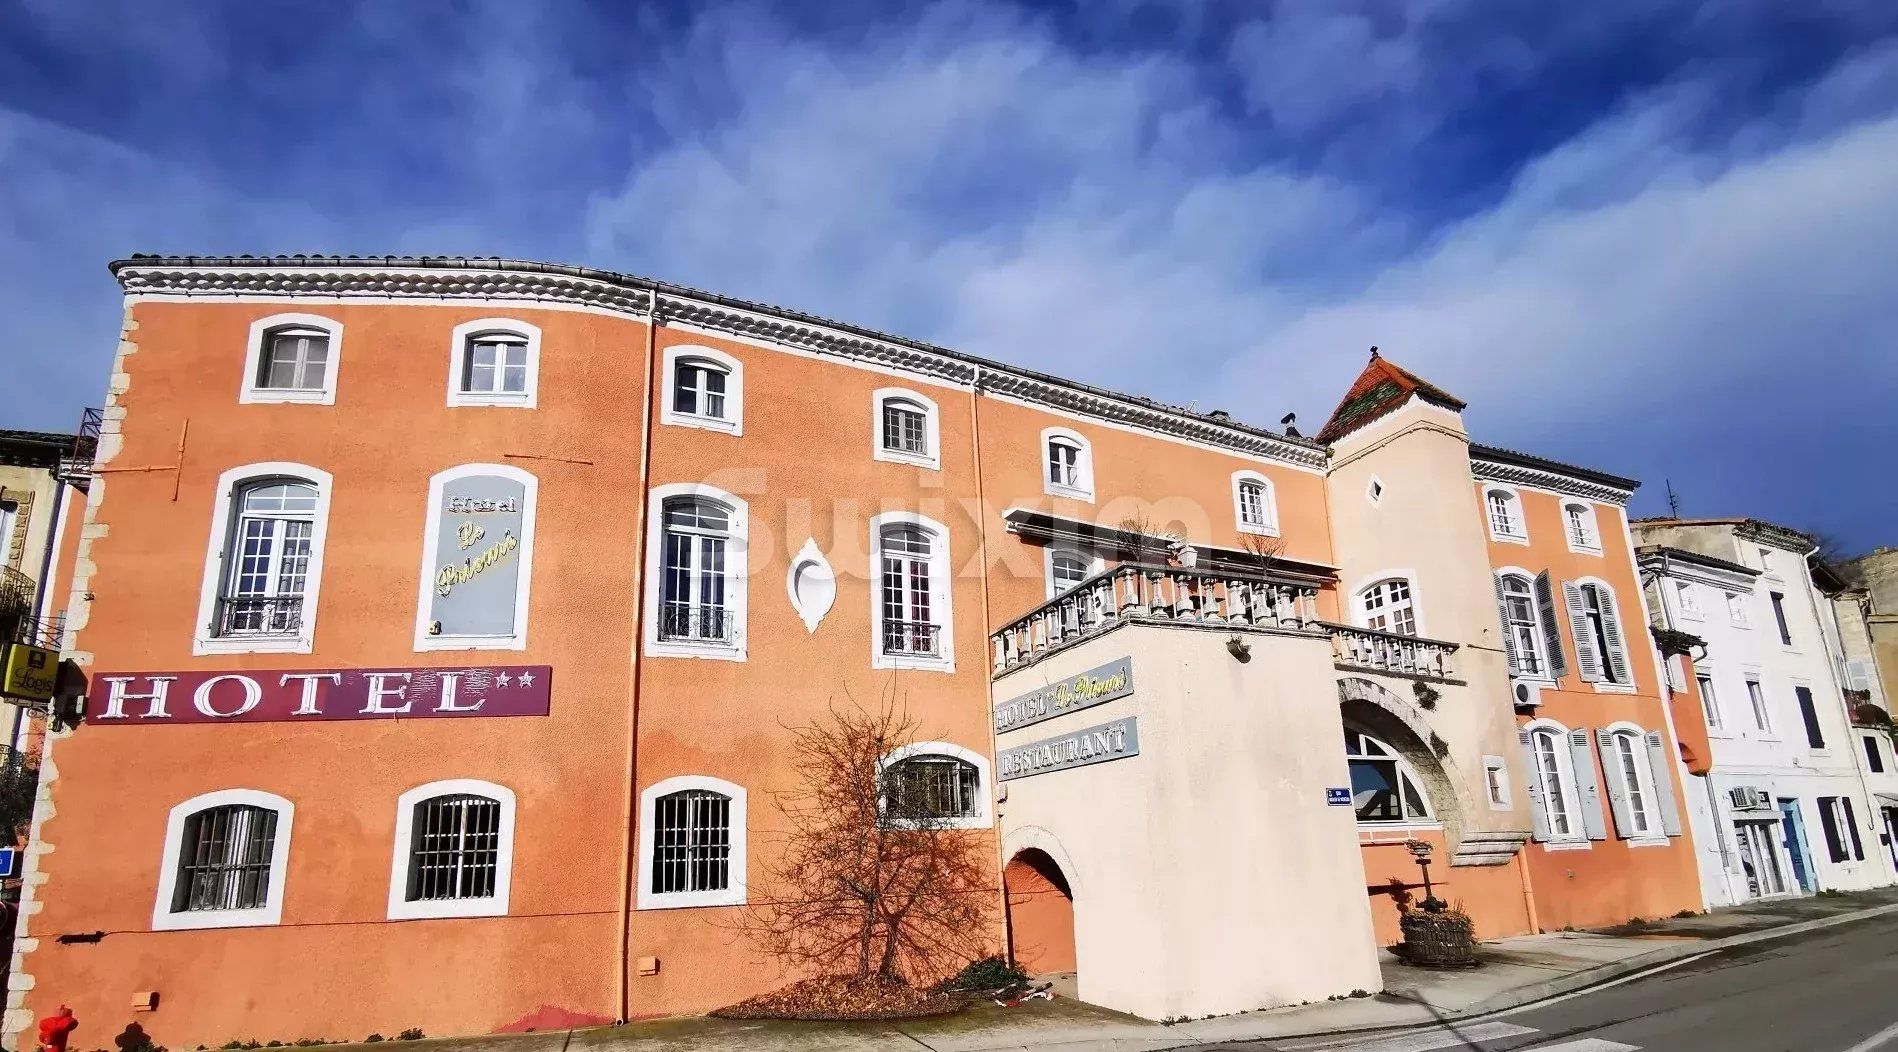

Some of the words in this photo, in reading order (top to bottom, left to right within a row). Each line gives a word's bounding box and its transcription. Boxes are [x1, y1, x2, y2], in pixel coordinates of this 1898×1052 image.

[11, 667, 53, 694] Logis
[97, 670, 486, 719] HOTEL
[995, 692, 1048, 730] HOTEL
[1002, 724, 1126, 775] RESTAURANT
